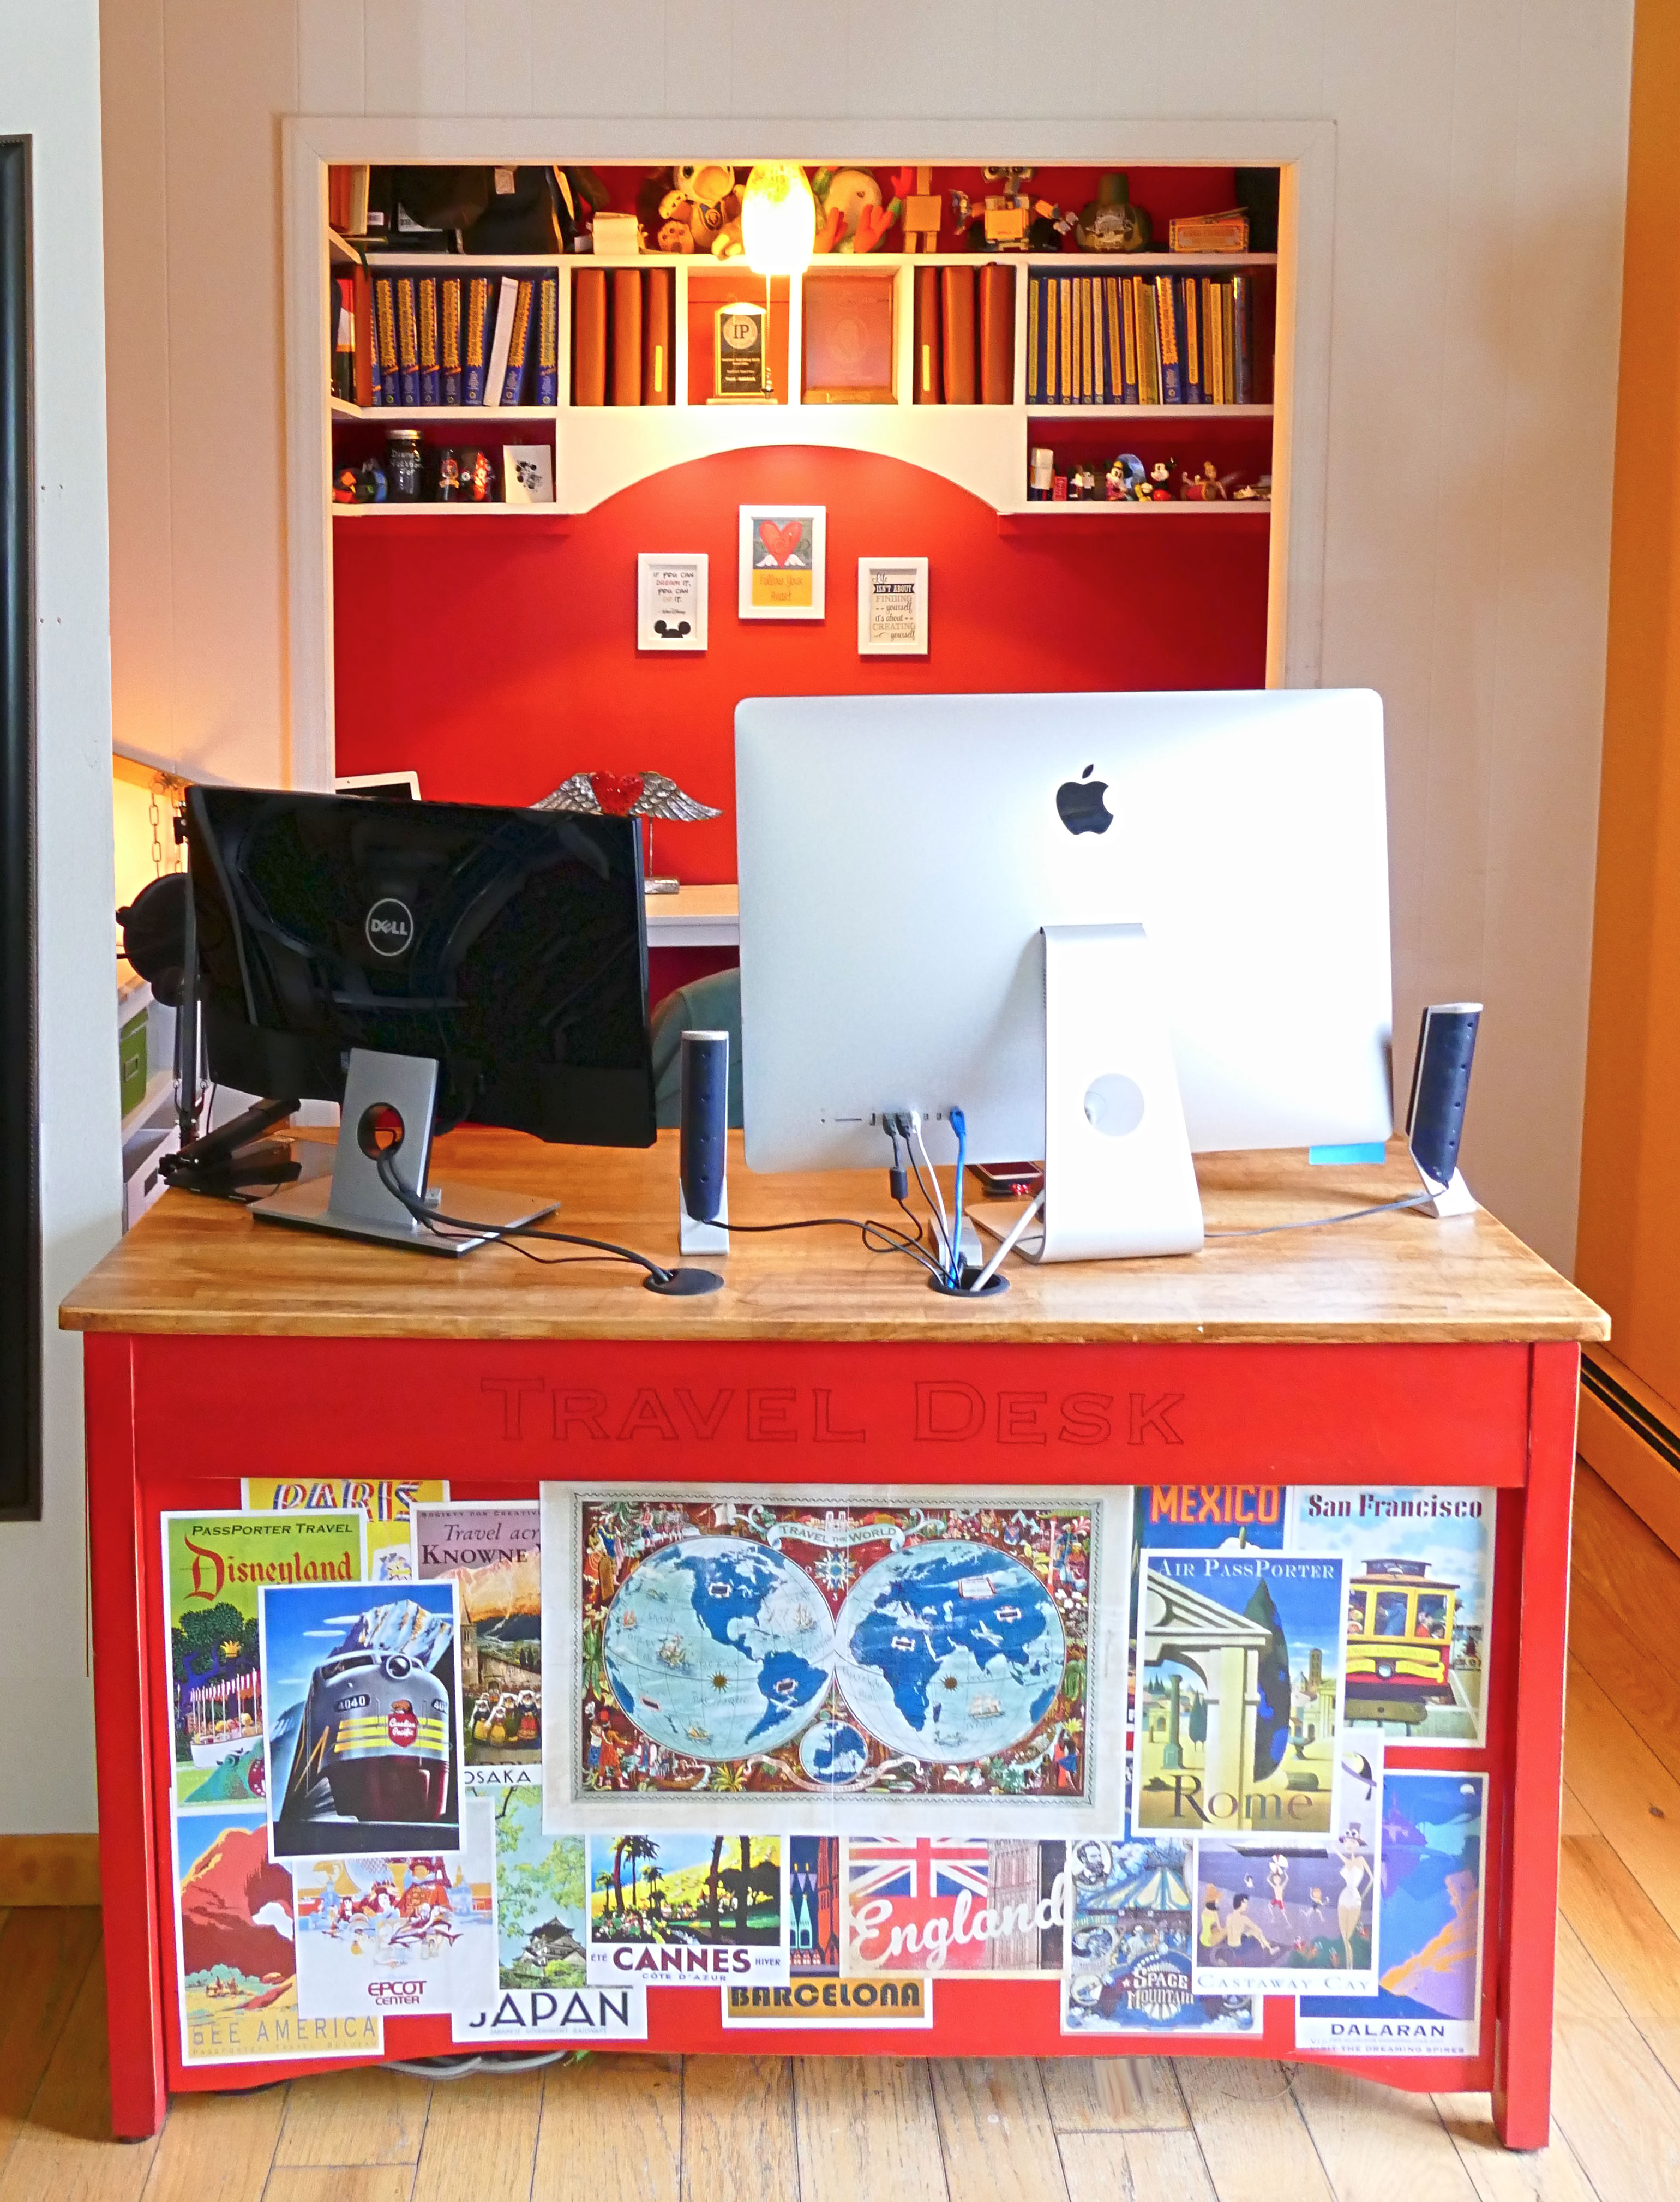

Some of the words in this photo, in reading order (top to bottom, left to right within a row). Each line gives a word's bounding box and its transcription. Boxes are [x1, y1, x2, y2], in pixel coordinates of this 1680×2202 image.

[733, 324, 750, 339] IP
[886, 613, 903, 622] about
[371, 919, 408, 936] DELL
[480, 1377, 866, 1443] TRAVEL
[913, 1380, 1185, 1445] DESK
[273, 1480, 423, 1522] PARIS
[1149, 1485, 1280, 1524] MEXICO
[1309, 1493, 1351, 1517] San
[1359, 1493, 1483, 1519] Francisco
[295, 1523, 353, 1534] TRAVEL
[444, 1522, 502, 1541] Travel
[779, 1525, 829, 1543] TRAVEL
[849, 1528, 896, 1543] WORLD
[421, 1544, 528, 1565] KNOWNE
[183, 1533, 352, 1601] Disneyland
[1159, 1558, 1195, 1577] AIR
[1169, 1774, 1313, 1825] Rome
[849, 1872, 1064, 1970] England
[613, 1945, 752, 1973] CANNES
[368, 1980, 427, 1996] EPCOT
[1132, 1966, 1188, 1989] SPACE
[1198, 1975, 1312, 1989] CASTAWAY
[1325, 1977, 1371, 1990] CAY
[375, 1995, 420, 2006] CENTER
[731, 1982, 919, 2007] BARCELONA
[1126, 1988, 1195, 2010] MOUNTAIN
[257, 2015, 376, 2042] AMERICA
[1330, 2023, 1445, 2037] DALARAN
